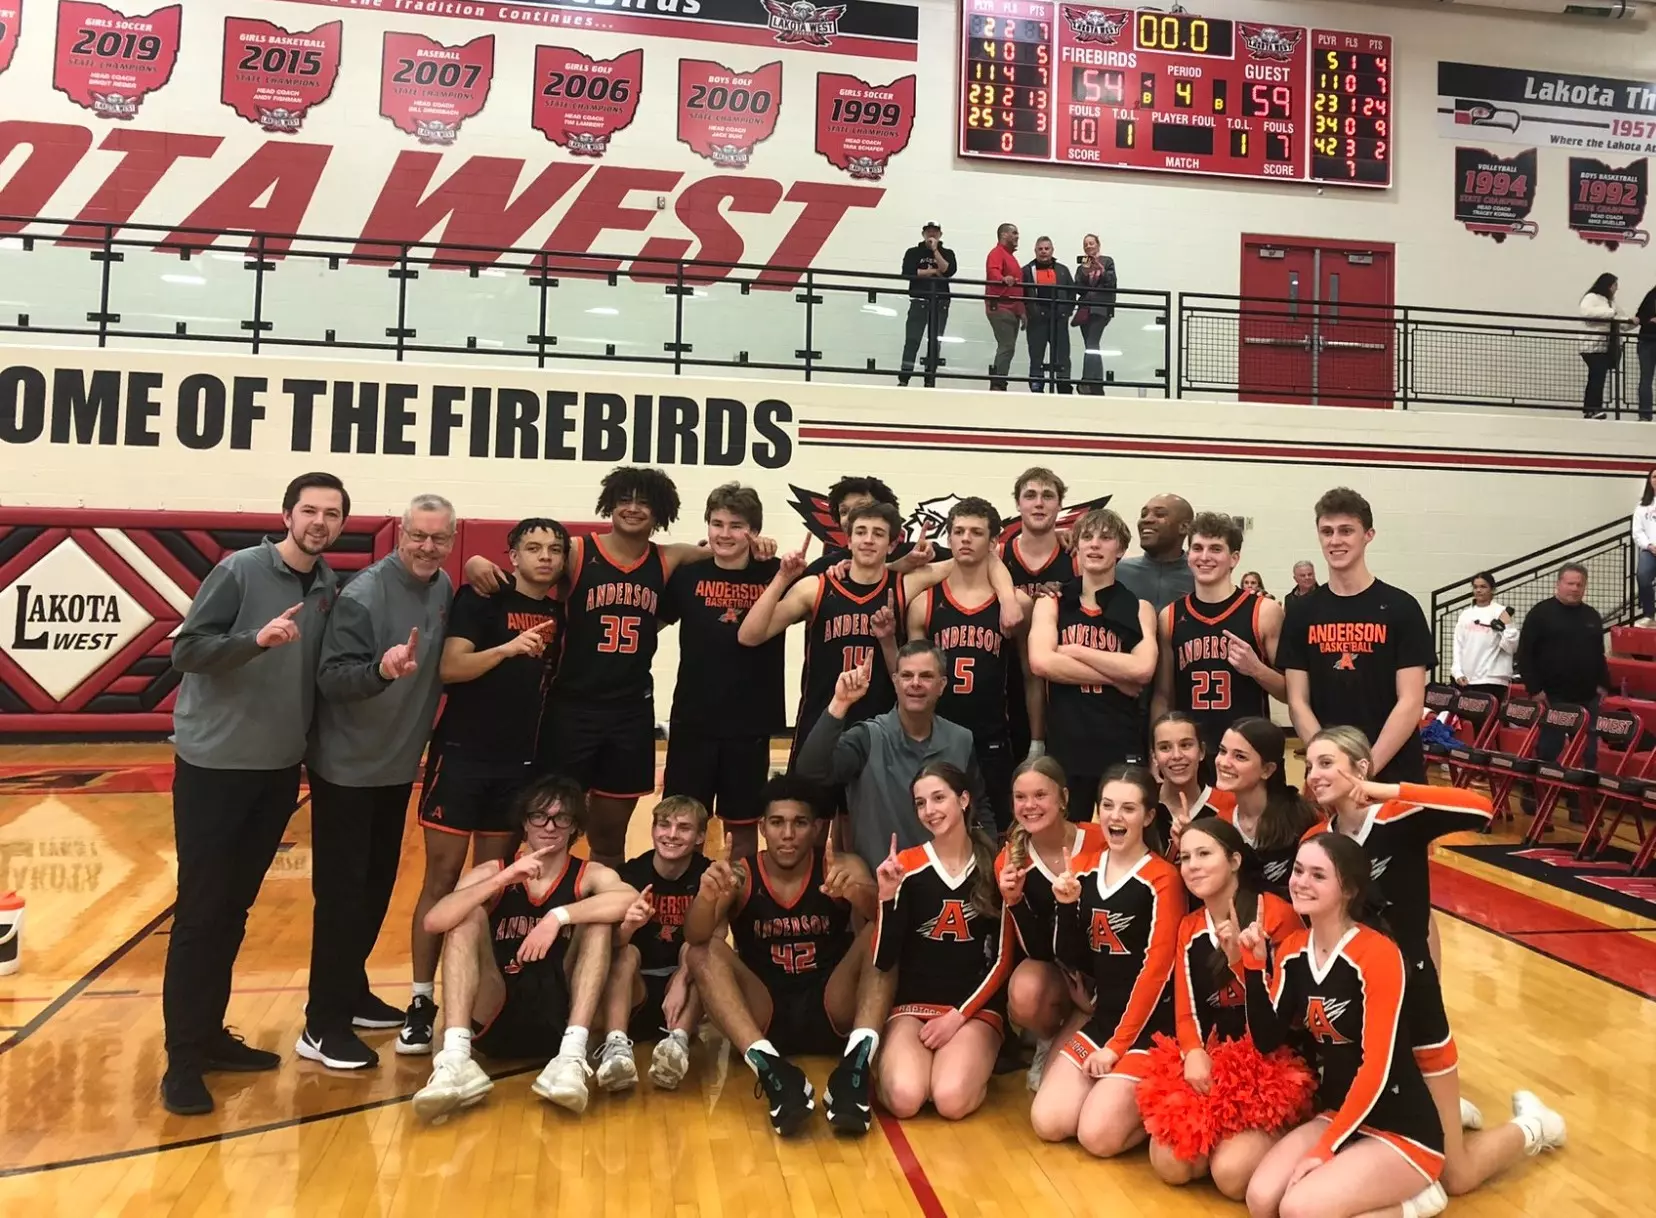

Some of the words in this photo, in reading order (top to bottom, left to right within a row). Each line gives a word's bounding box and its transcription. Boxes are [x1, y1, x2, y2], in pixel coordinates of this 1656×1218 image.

[394, 0, 485, 16] Tradition
[1030, 6, 1045, 16] PTS
[85, 18, 113, 28] GIRLS
[115, 20, 153, 32] SOCCER
[773, 16, 807, 31] LAKOTA
[810, 22, 833, 32] WEST
[984, 17, 995, 37] 2
[1004, 19, 1016, 39] 2
[1039, 22, 1048, 40] 7
[71, 28, 162, 61] 2019
[239, 33, 266, 43] GIRLS
[268, 35, 326, 48] BASKETBALL
[1318, 34, 1337, 45] PLYR
[1345, 37, 1358, 48] FLS
[1369, 40, 1383, 50] PTS
[238, 44, 324, 76] 2015
[416, 49, 461, 60] BASEBALL
[983, 41, 995, 58] 4
[1003, 42, 1015, 61] 0
[1037, 45, 1048, 64] 5
[1062, 46, 1137, 68] FIREBIRDS
[1327, 51, 1339, 70] 5
[1375, 57, 1386, 73] 4
[99, 61, 157, 72] CHAMPIONS
[392, 58, 483, 90] 2007
[564, 62, 589, 72] GIRLS
[591, 64, 613, 74] GOLF
[976, 63, 995, 80] 11
[1003, 66, 1014, 82] 4
[1038, 68, 1047, 85] 7
[1167, 65, 1202, 78] PERIOD
[1245, 64, 1290, 82] GUEST
[265, 76, 320, 87] CHAMPIONS
[542, 71, 631, 103] 2006
[708, 75, 730, 84] BOYS
[731, 77, 753, 86] GOLF
[1083, 69, 1122, 102] 54
[1321, 73, 1338, 90] 11
[1345, 74, 1357, 93] 0
[1377, 77, 1386, 94] 7
[1523, 76, 1615, 107] Lakota
[422, 90, 474, 100] CHAMPIONS
[686, 84, 772, 115] 2000
[839, 88, 861, 97] GIRLS
[863, 90, 894, 100] SOCCER
[969, 84, 994, 105] 23
[1002, 87, 1014, 106] 2
[1029, 90, 1047, 109] 13
[1142, 92, 1152, 104] B
[1176, 82, 1191, 105] 4
[1214, 98, 1224, 110] B
[1252, 85, 1289, 117] 59
[1314, 93, 1338, 112] 23
[1363, 97, 1386, 116] 24
[545, 100, 568, 108] STATE
[572, 102, 624, 113] CHAMPIONS
[830, 98, 901, 127] 1999
[1069, 104, 1101, 117] FOULS
[1112, 108, 1139, 120] T.O.L.
[968, 106, 994, 128] 25
[1002, 111, 1013, 128] 4
[1037, 112, 1047, 132] 3
[1152, 111, 1189, 125] PLAYER
[1192, 115, 1216, 127] FOUL
[1226, 118, 1253, 130] T.O.L.
[1263, 121, 1294, 134] FOULS
[1316, 115, 1338, 133] 34
[1345, 117, 1356, 136] 0
[1375, 120, 1386, 137] 9
[1611, 119, 1656, 138] 1957
[852, 127, 900, 137] CHAMPIONS
[1001, 132, 1013, 152] 0
[1073, 118, 1095, 144] 10
[1127, 124, 1133, 146] 1
[1241, 133, 1247, 155] 1
[1277, 135, 1289, 158] 7
[1314, 137, 1338, 156] 42
[1346, 139, 1355, 157] 3
[1375, 141, 1386, 160] 2
[1550, 134, 1583, 147] Where
[1586, 139, 1604, 148] the
[1607, 140, 1641, 152] Lakota
[1068, 148, 1100, 161] SCORE
[1165, 156, 1200, 169] MATCH
[1263, 163, 1294, 175] SCORE
[1346, 160, 1355, 177] 7
[1478, 163, 1517, 172] VOLLEYBALL
[1599, 173, 1638, 182] BASKETBALL
[1464, 170, 1527, 197] 1994
[1579, 179, 1638, 205] 1992
[348, 149, 886, 291] WEST
[176, 374, 268, 450] OF
[283, 378, 419, 455] THE
[430, 386, 793, 470] FIREBIRDS
[586, 582, 658, 615] ANDERSON
[12, 585, 121, 650] LAKOTA
[824, 614, 877, 642] ANDERS
[53, 632, 118, 650] WEST
[598, 615, 641, 653] 35
[1062, 623, 1121, 653] ANDERSO
[1308, 622, 1387, 645] ANDERSON
[1179, 635, 1231, 670] ANDERS
[1320, 641, 1373, 653] BASKETBALL
[953, 657, 975, 694] 5
[1191, 671, 1231, 710] 23
[1596, 715, 1634, 735] WEST
[771, 942, 817, 974] 42
